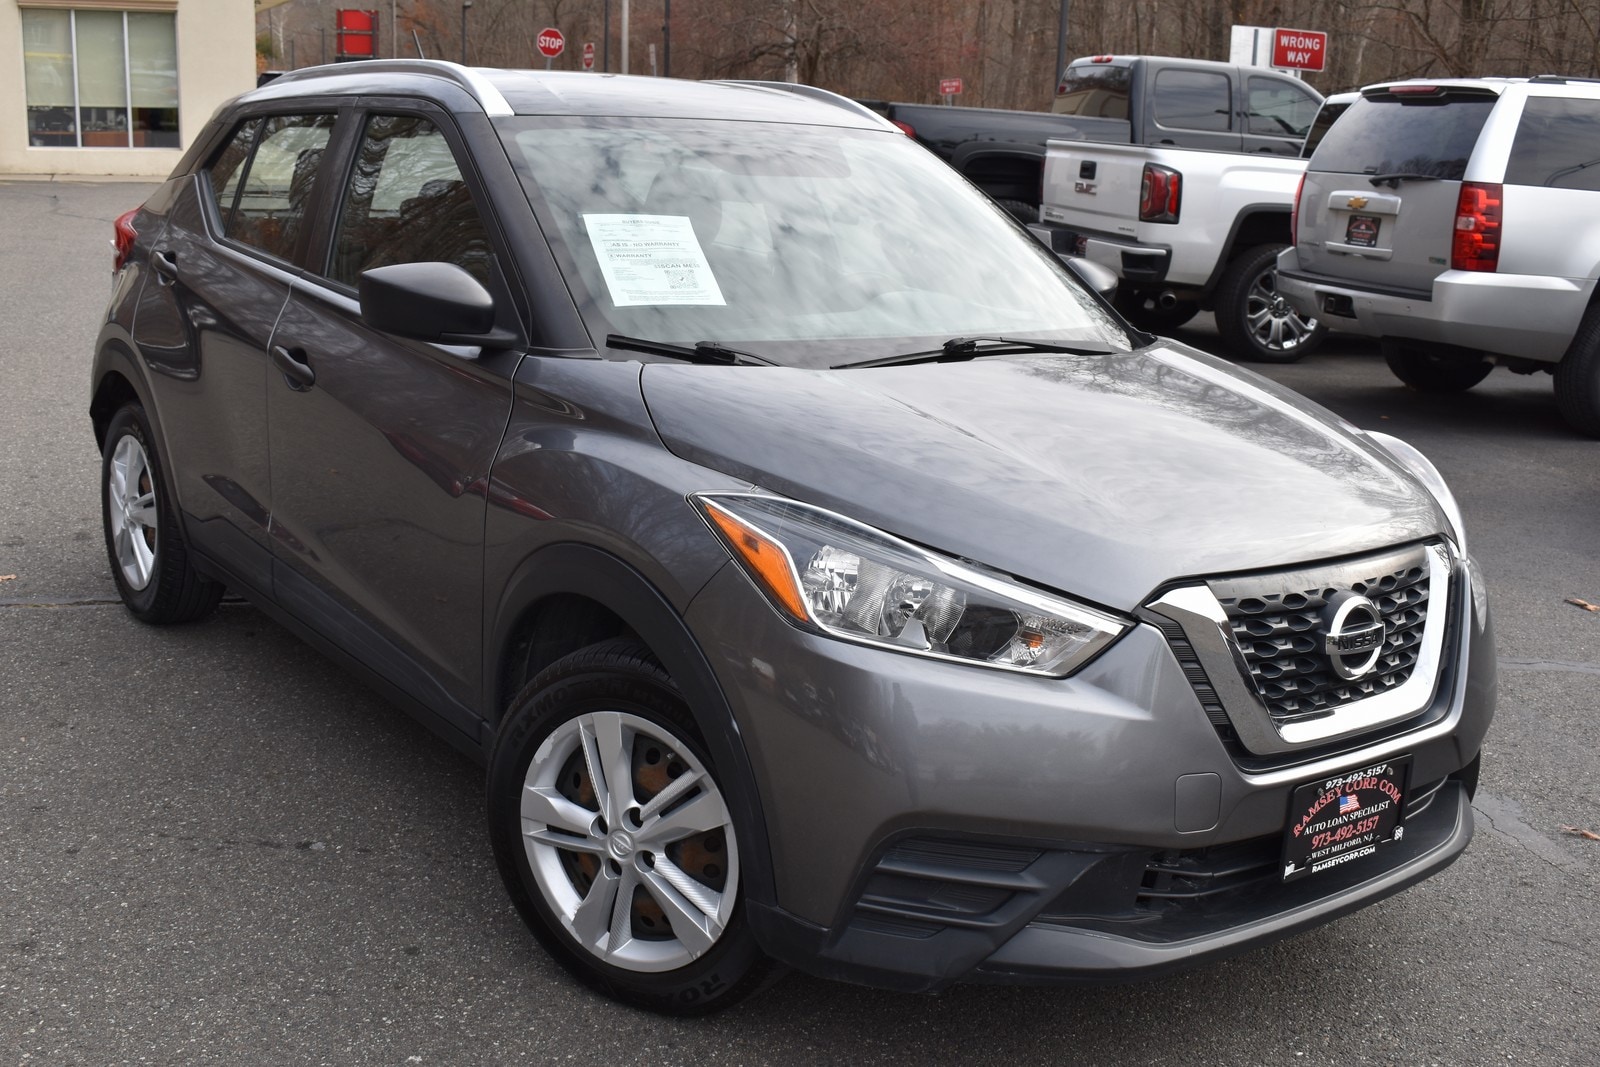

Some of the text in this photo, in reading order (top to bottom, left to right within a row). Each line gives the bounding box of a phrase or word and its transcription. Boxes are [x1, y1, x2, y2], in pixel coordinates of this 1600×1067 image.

[539, 36, 563, 49] STOP
[1280, 35, 1320, 50] WRONG
[1287, 50, 1311, 64] WAY
[1074, 181, 1097, 195] GMC
[1325, 764, 1387, 790] 973-492-5157
[1293, 785, 1343, 837] RAMSEY
[1379, 779, 1402, 805] COM
[1303, 800, 1390, 836] AUTO LOAN SPECIALIST
[1311, 815, 1379, 850] 973-492-5157
[1311, 847, 1331, 859] WEST
[1311, 846, 1376, 873] RAMSEYCORP.COM
